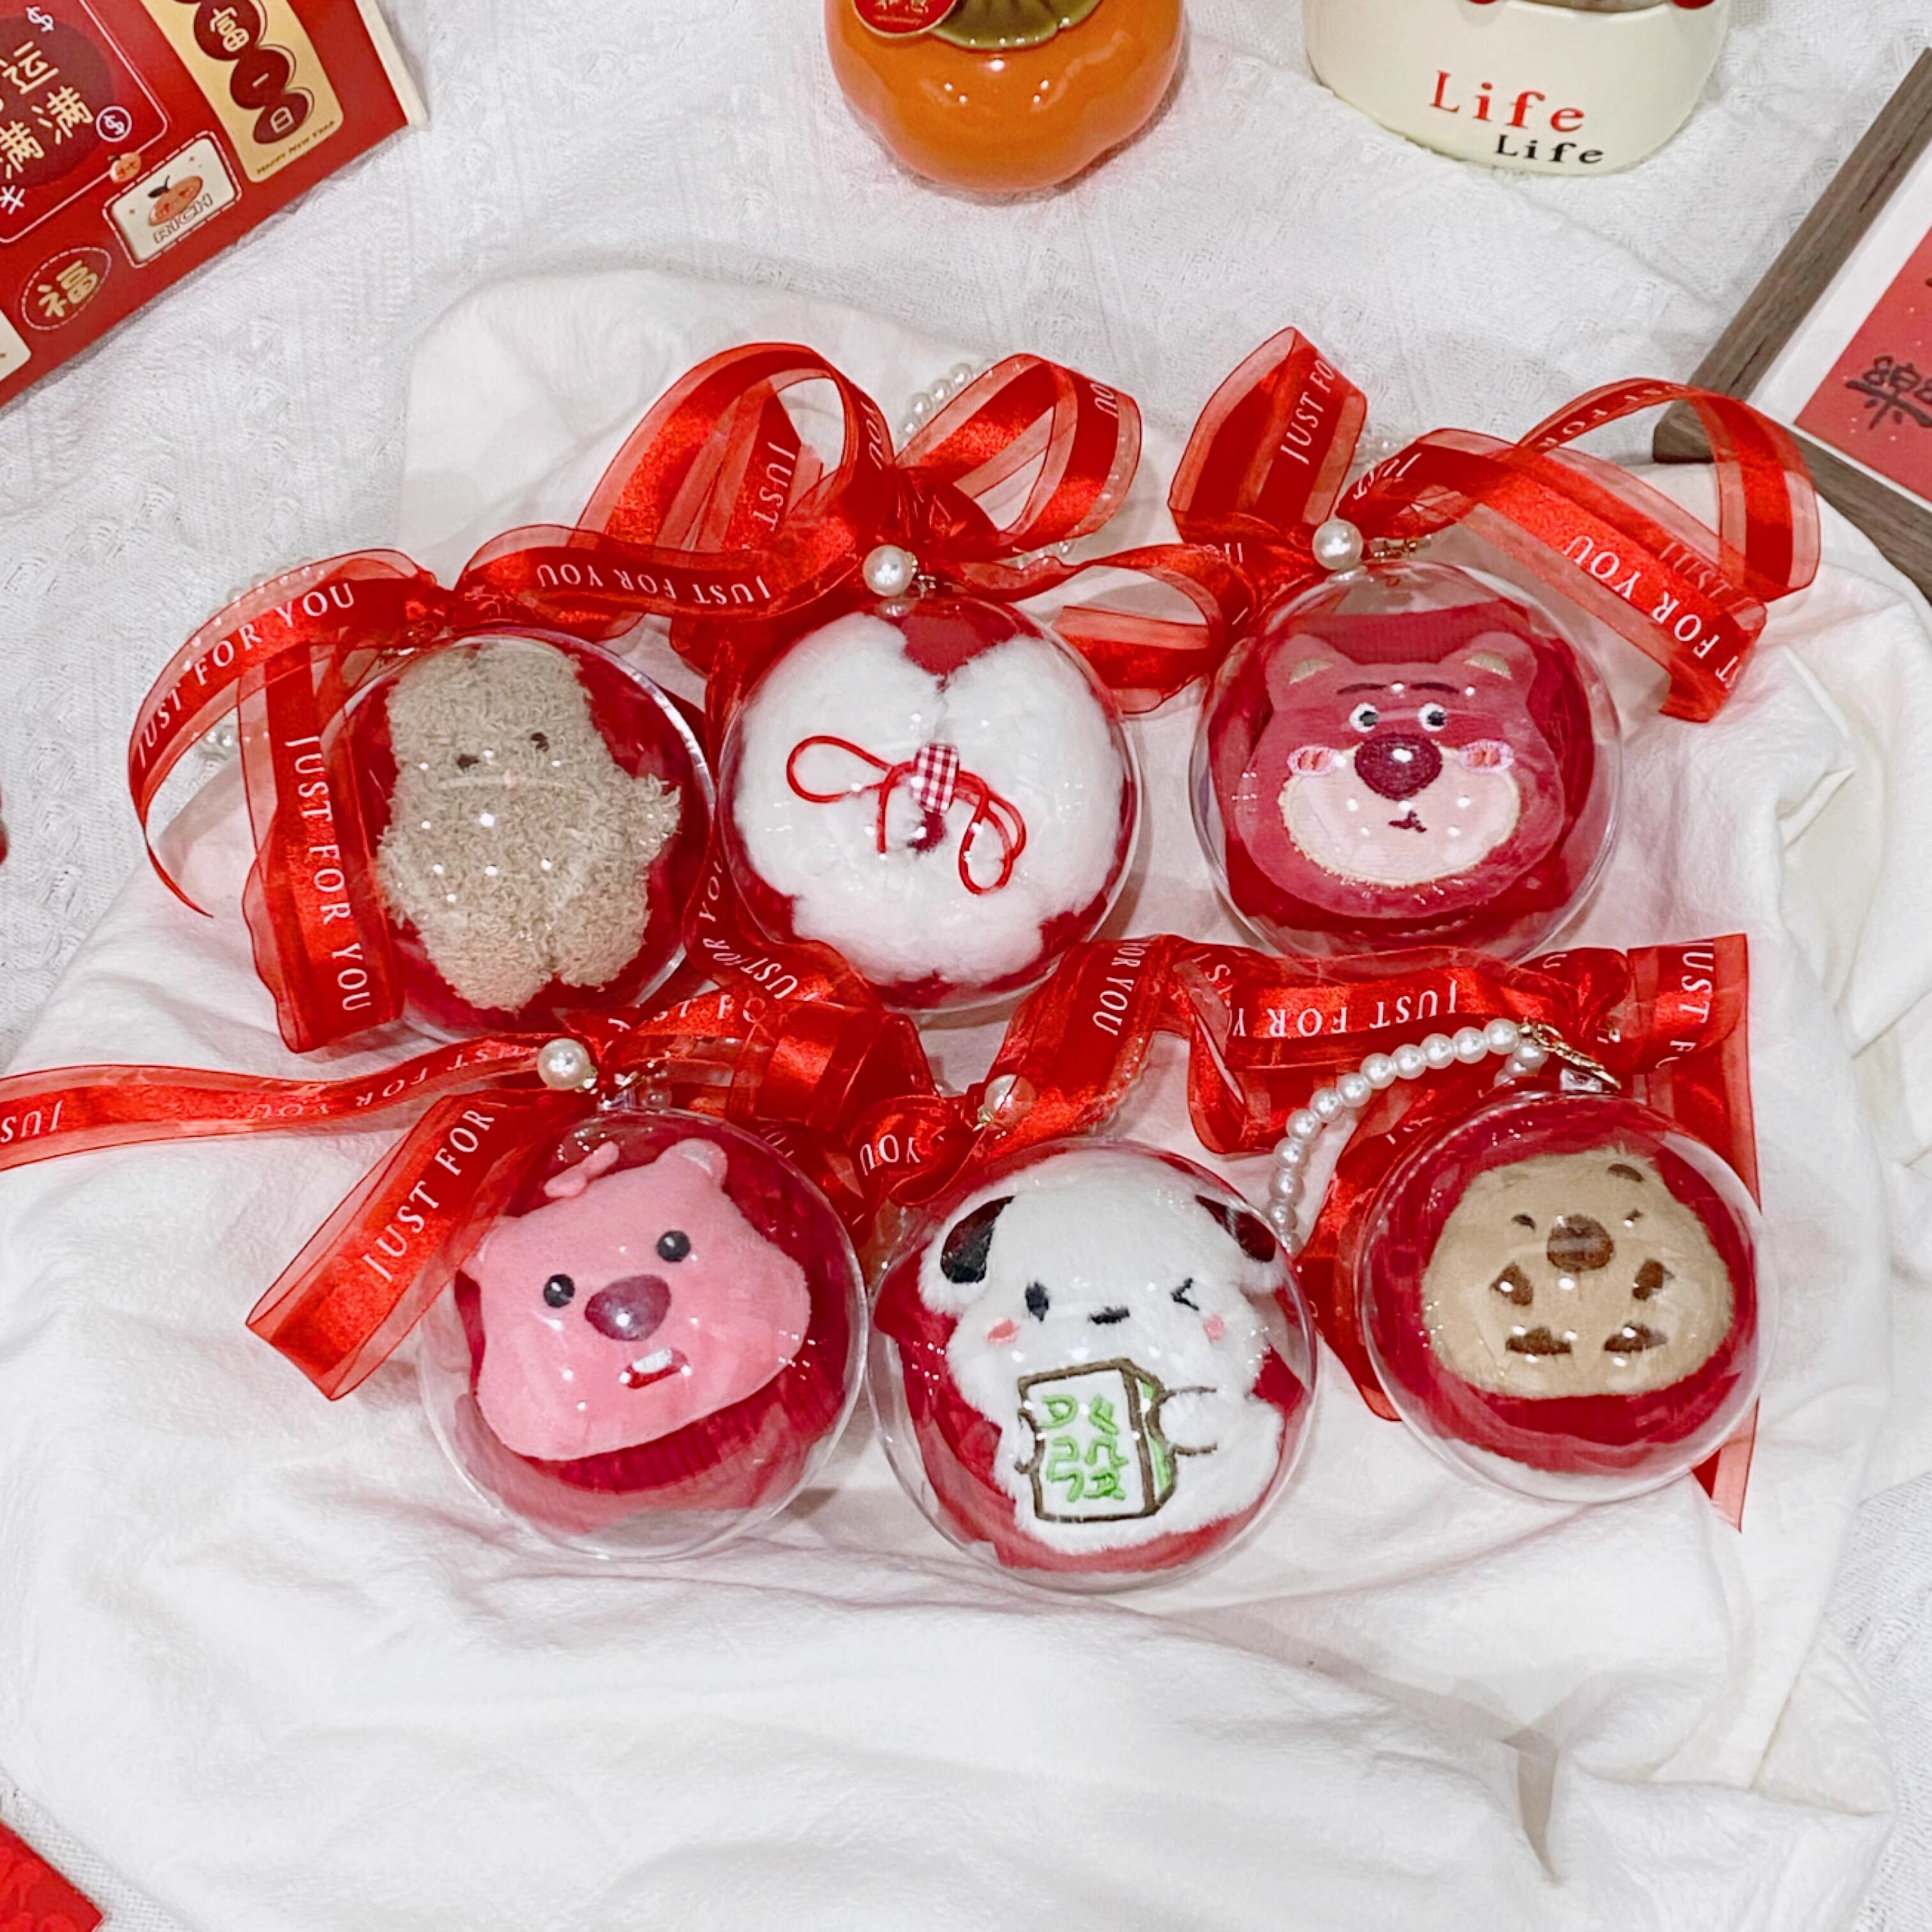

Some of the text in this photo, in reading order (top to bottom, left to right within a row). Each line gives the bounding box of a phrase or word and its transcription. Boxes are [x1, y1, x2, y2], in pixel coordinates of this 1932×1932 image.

[0, 41, 59, 96] 运
[1429, 69, 1585, 133] Life
[1495, 134, 1604, 164] Life
[37, 259, 98, 318] 福
[1090, 383, 1119, 418] OU
[1280, 359, 1337, 465] JUST FO
[753, 441, 796, 532] JUST
[537, 564, 771, 604] JUST FOR YOU
[1562, 535, 1641, 599] YOU
[1652, 591, 1720, 659] FOR
[138, 583, 355, 769] JUST FOR YOU
[284, 735, 372, 1011] JUST FOR YOU
[1092, 976, 1135, 1036] YOU
[1267, 1006, 1348, 1038] FOR
[1369, 979, 1457, 1029] JUST
[0, 1100, 64, 1143] JUS
[860, 1134, 921, 1176] YOU
[362, 1110, 495, 1283] JUST FOR
